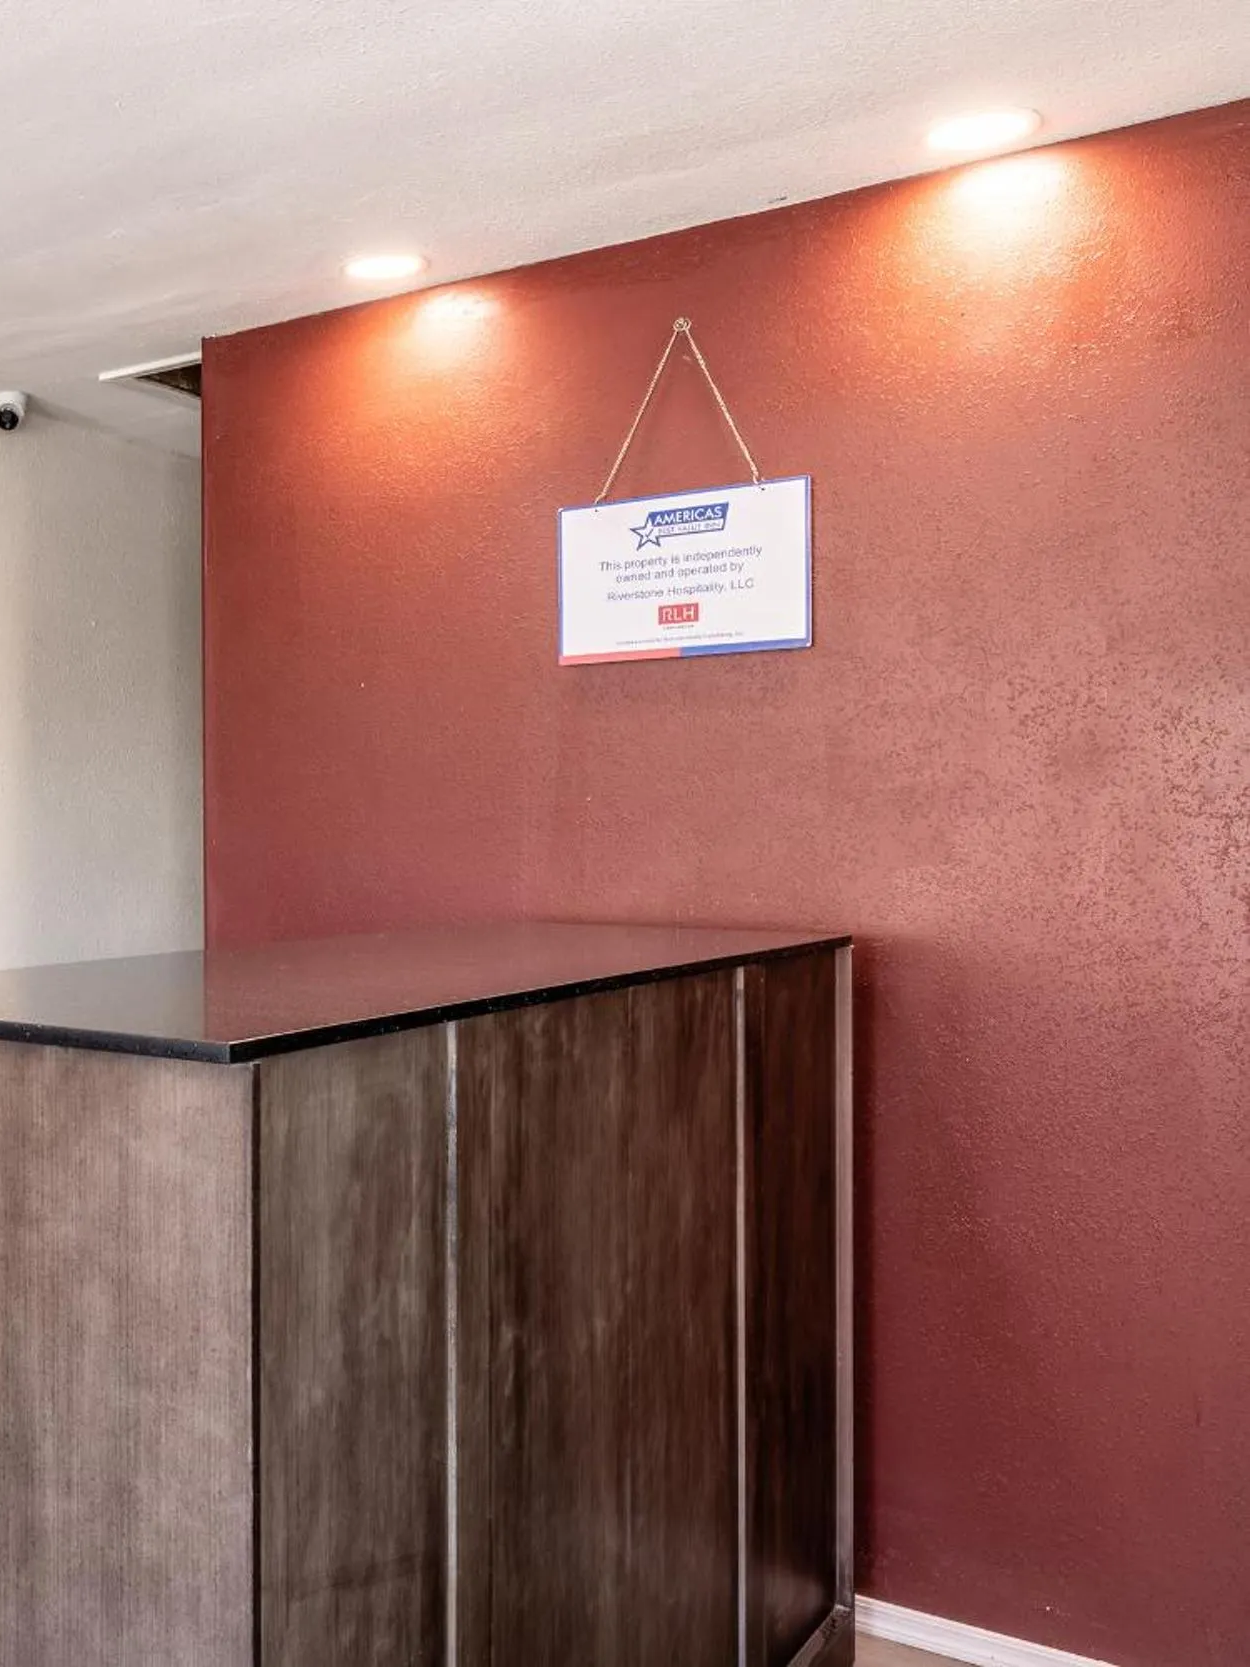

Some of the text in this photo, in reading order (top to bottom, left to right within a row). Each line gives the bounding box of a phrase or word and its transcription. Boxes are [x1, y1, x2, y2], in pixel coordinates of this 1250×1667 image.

[654, 506, 723, 525] AMERICAS
[599, 545, 762, 571] This property is independently
[616, 560, 745, 583] owned and operated by
[607, 588, 665, 601] Riverstone
[730, 577, 755, 590] LLC
[662, 605, 696, 622] RLH
